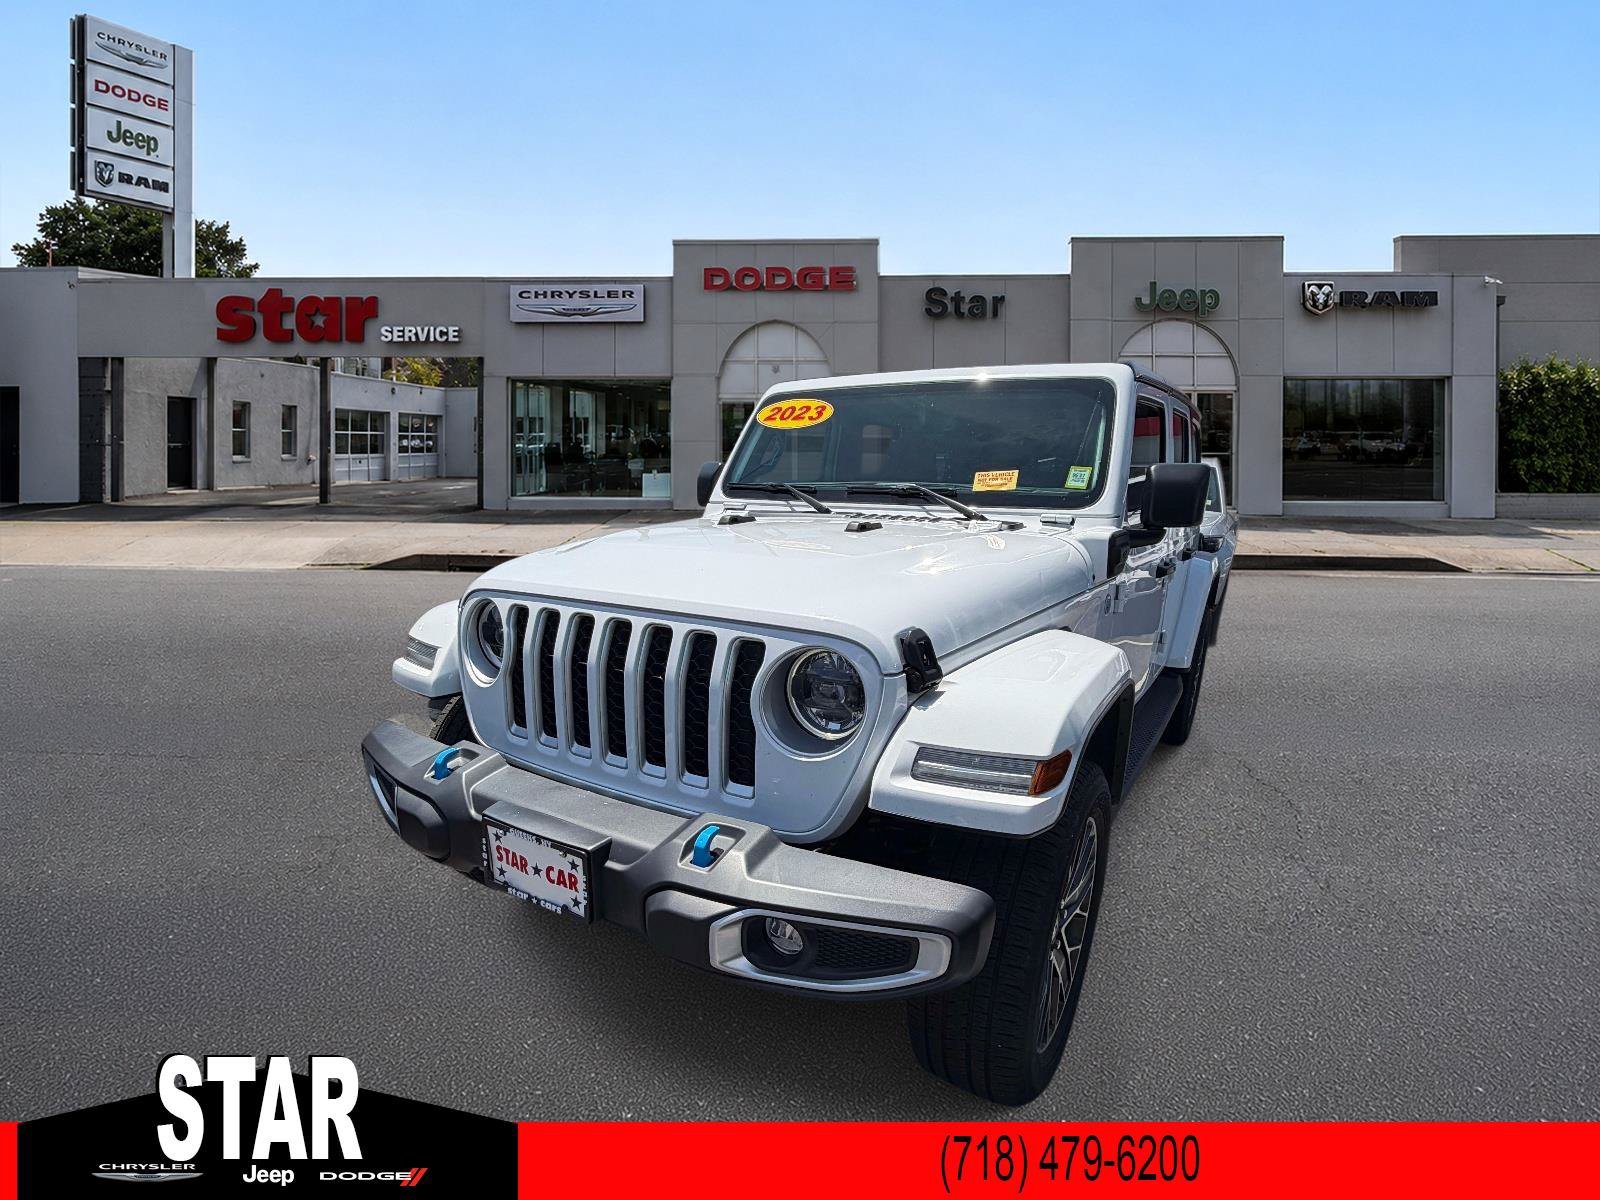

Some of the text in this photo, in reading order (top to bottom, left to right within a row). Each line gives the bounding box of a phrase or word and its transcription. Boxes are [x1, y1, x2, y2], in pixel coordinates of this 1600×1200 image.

[97, 31, 168, 61] CHRYSLER
[94, 79, 169, 111] DODGE
[107, 120, 159, 155] Jeep
[118, 172, 169, 193] RAM
[703, 266, 857, 292] DODGE
[518, 290, 635, 299] CHRYSLER
[924, 286, 1006, 320] Star
[1135, 281, 1221, 317] Jeep
[1339, 291, 1438, 308] RAM
[216, 288, 379, 343] star
[380, 326, 461, 343] SERVICE
[763, 404, 827, 421] 2023
[495, 844, 530, 876] STAR
[545, 865, 580, 893] CAR
[507, 886, 562, 915] star cars
